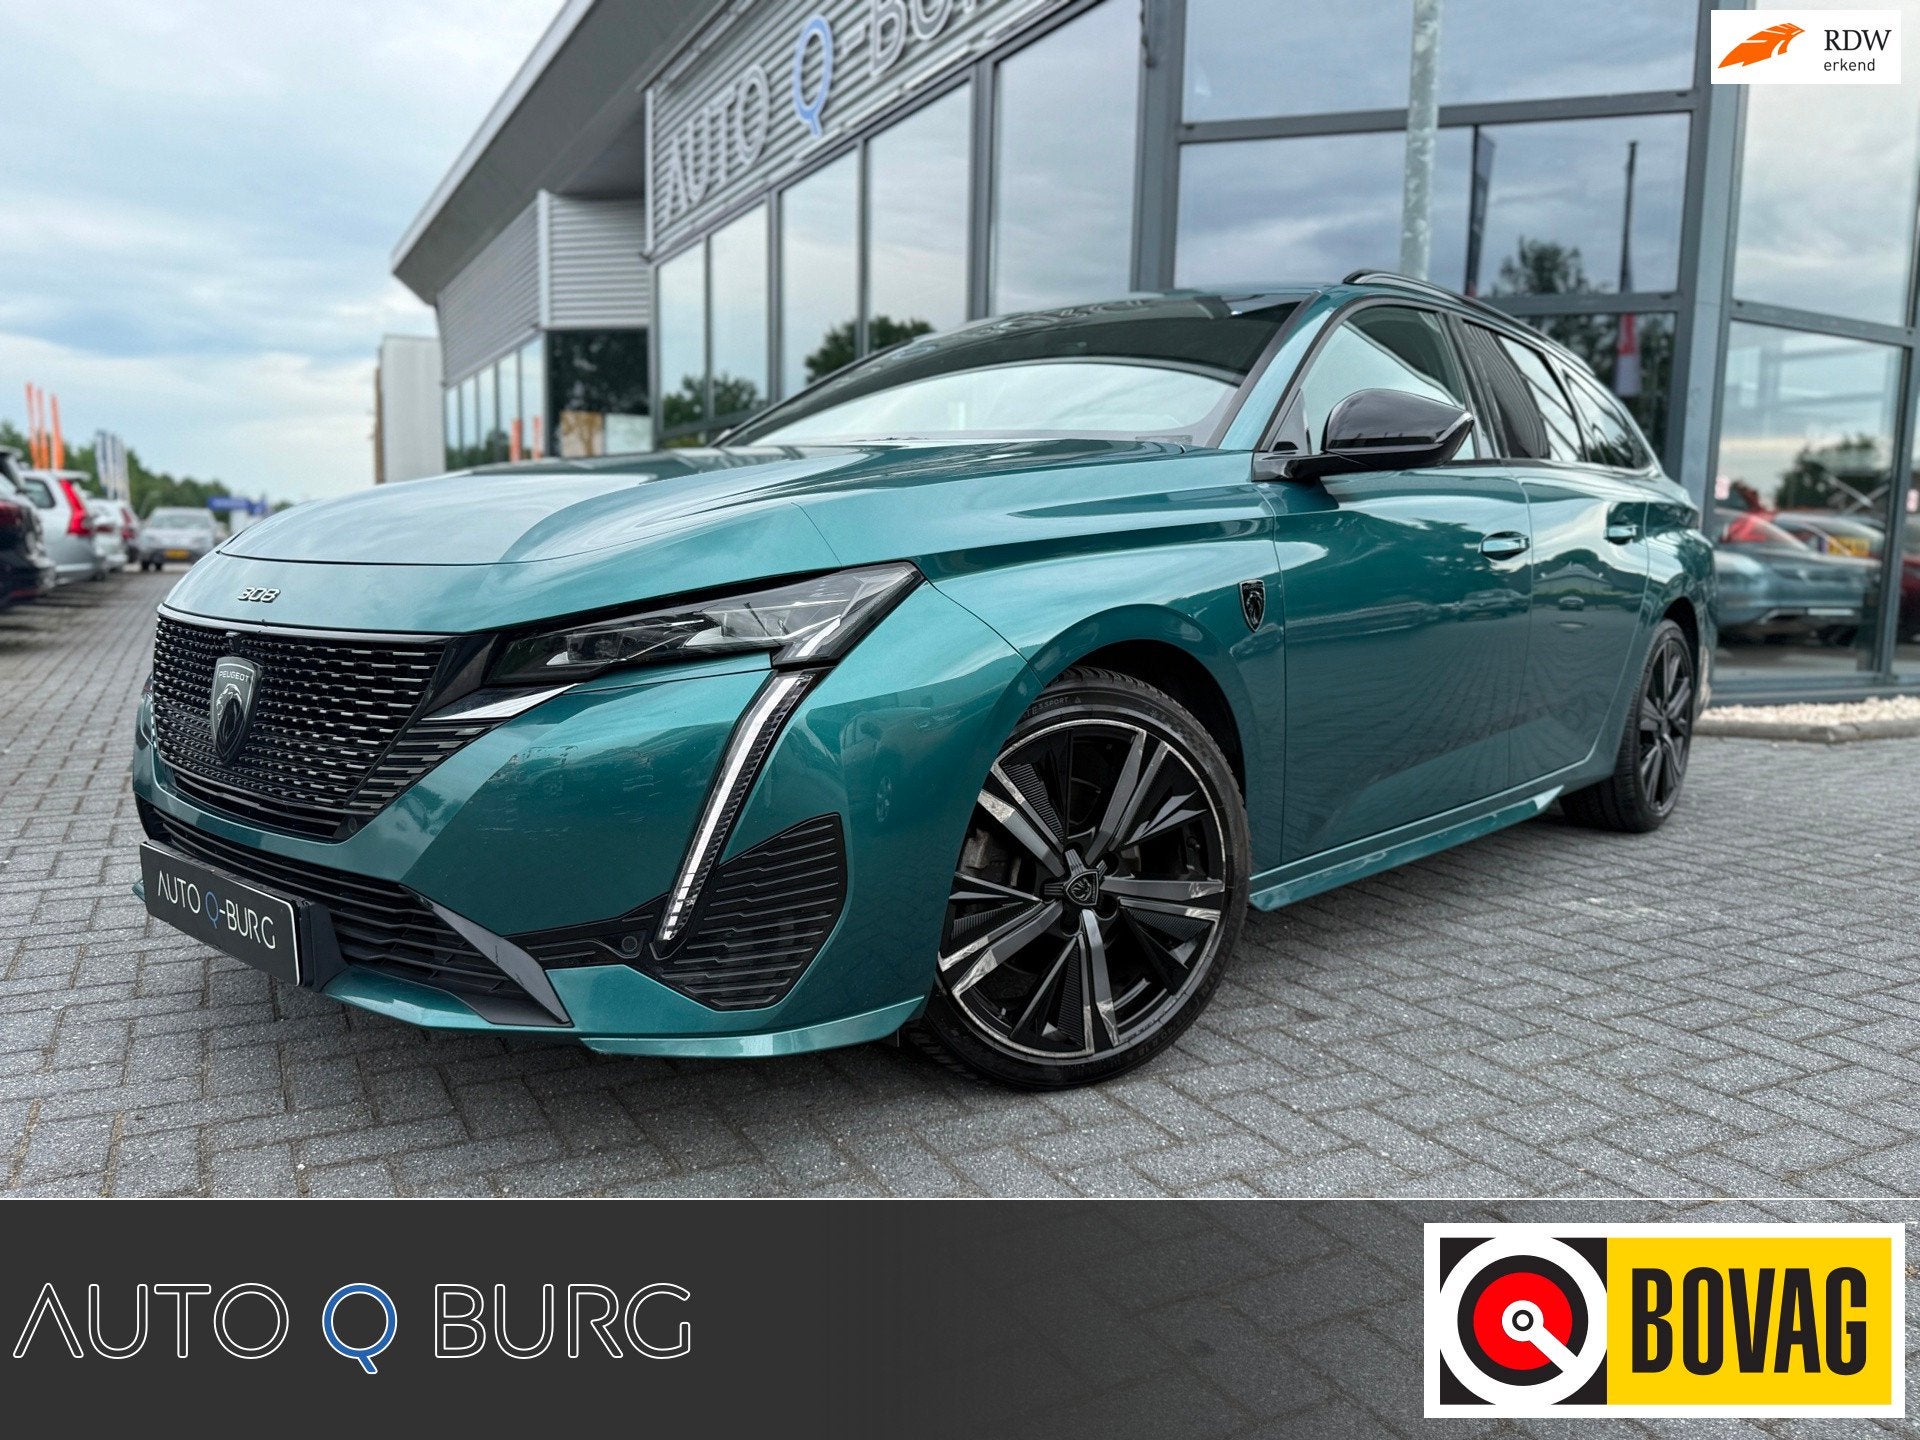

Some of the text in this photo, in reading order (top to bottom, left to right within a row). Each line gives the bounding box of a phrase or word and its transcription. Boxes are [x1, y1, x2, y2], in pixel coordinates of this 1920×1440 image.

[663, 63, 770, 225] AUTO
[237, 587, 281, 603] 308
[218, 670, 250, 683] PEUGEOT
[157, 870, 276, 950] AUTO Q-BURG
